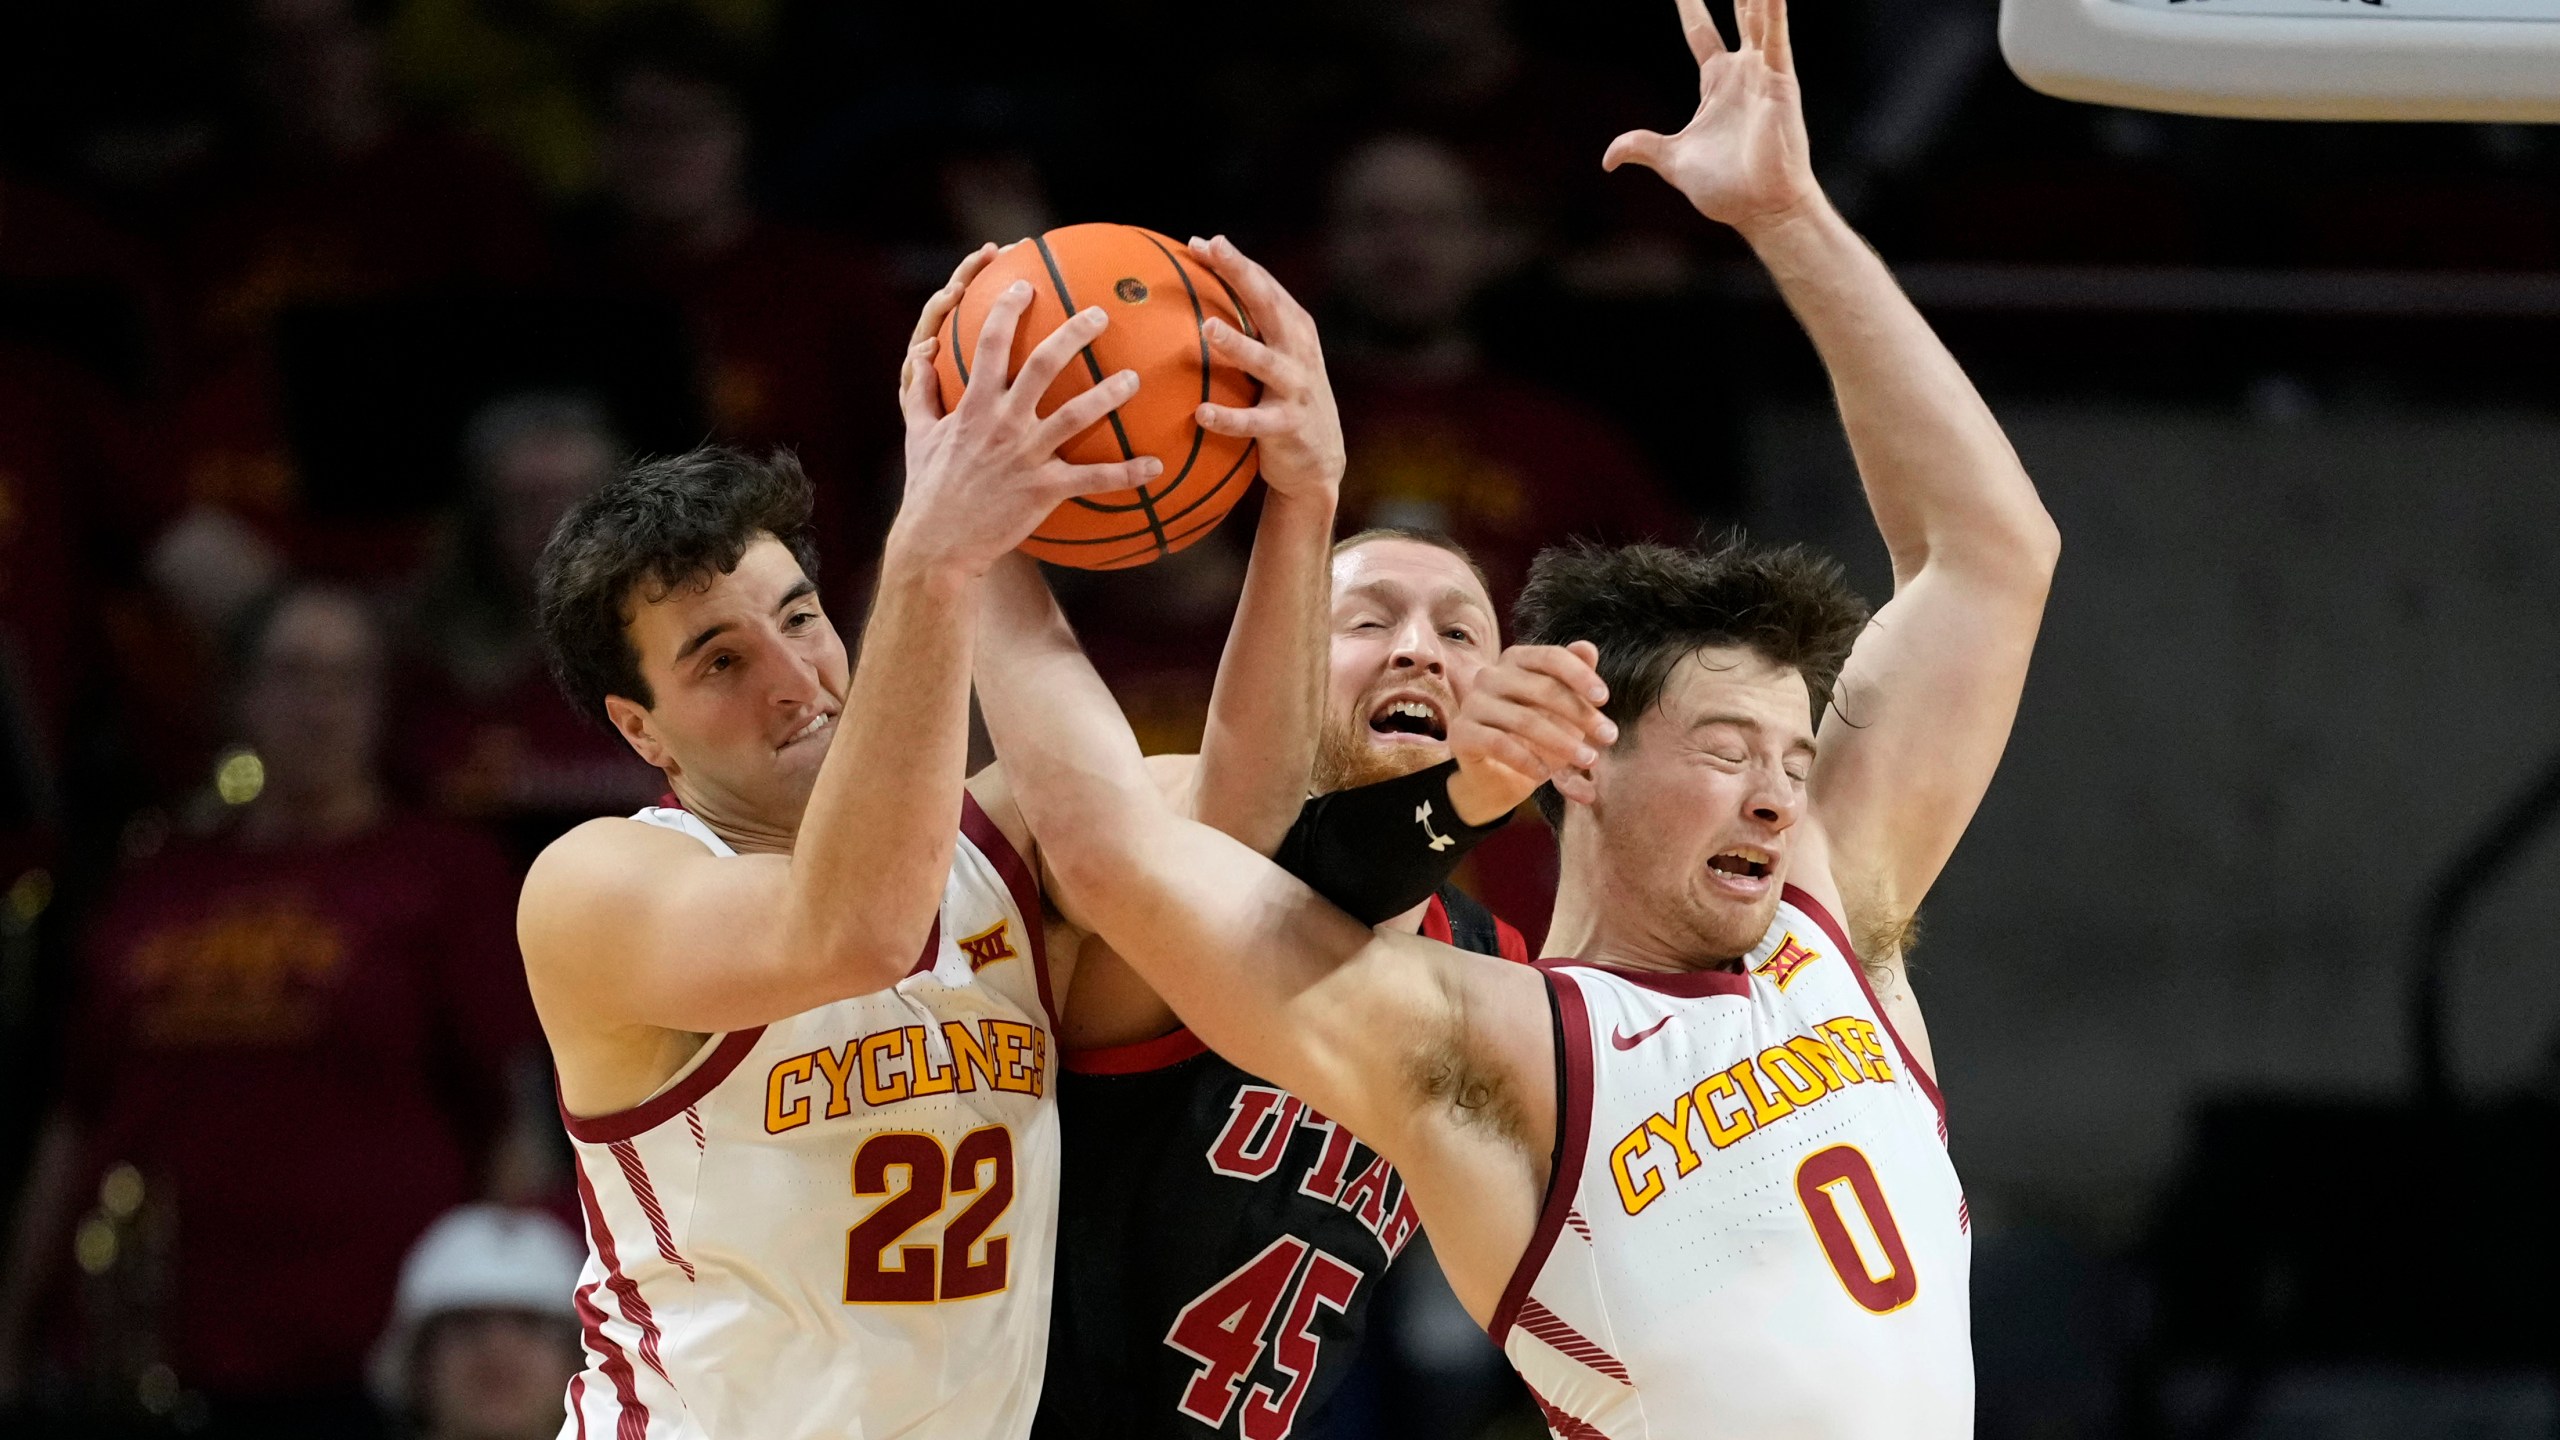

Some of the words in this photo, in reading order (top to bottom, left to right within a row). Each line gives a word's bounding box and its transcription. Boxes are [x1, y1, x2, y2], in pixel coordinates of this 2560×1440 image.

[1751, 930, 1822, 993] XII
[843, 1122, 1016, 1305] 22
[1793, 1142, 1919, 1316] 0
[1163, 1233, 1364, 1440] 45
